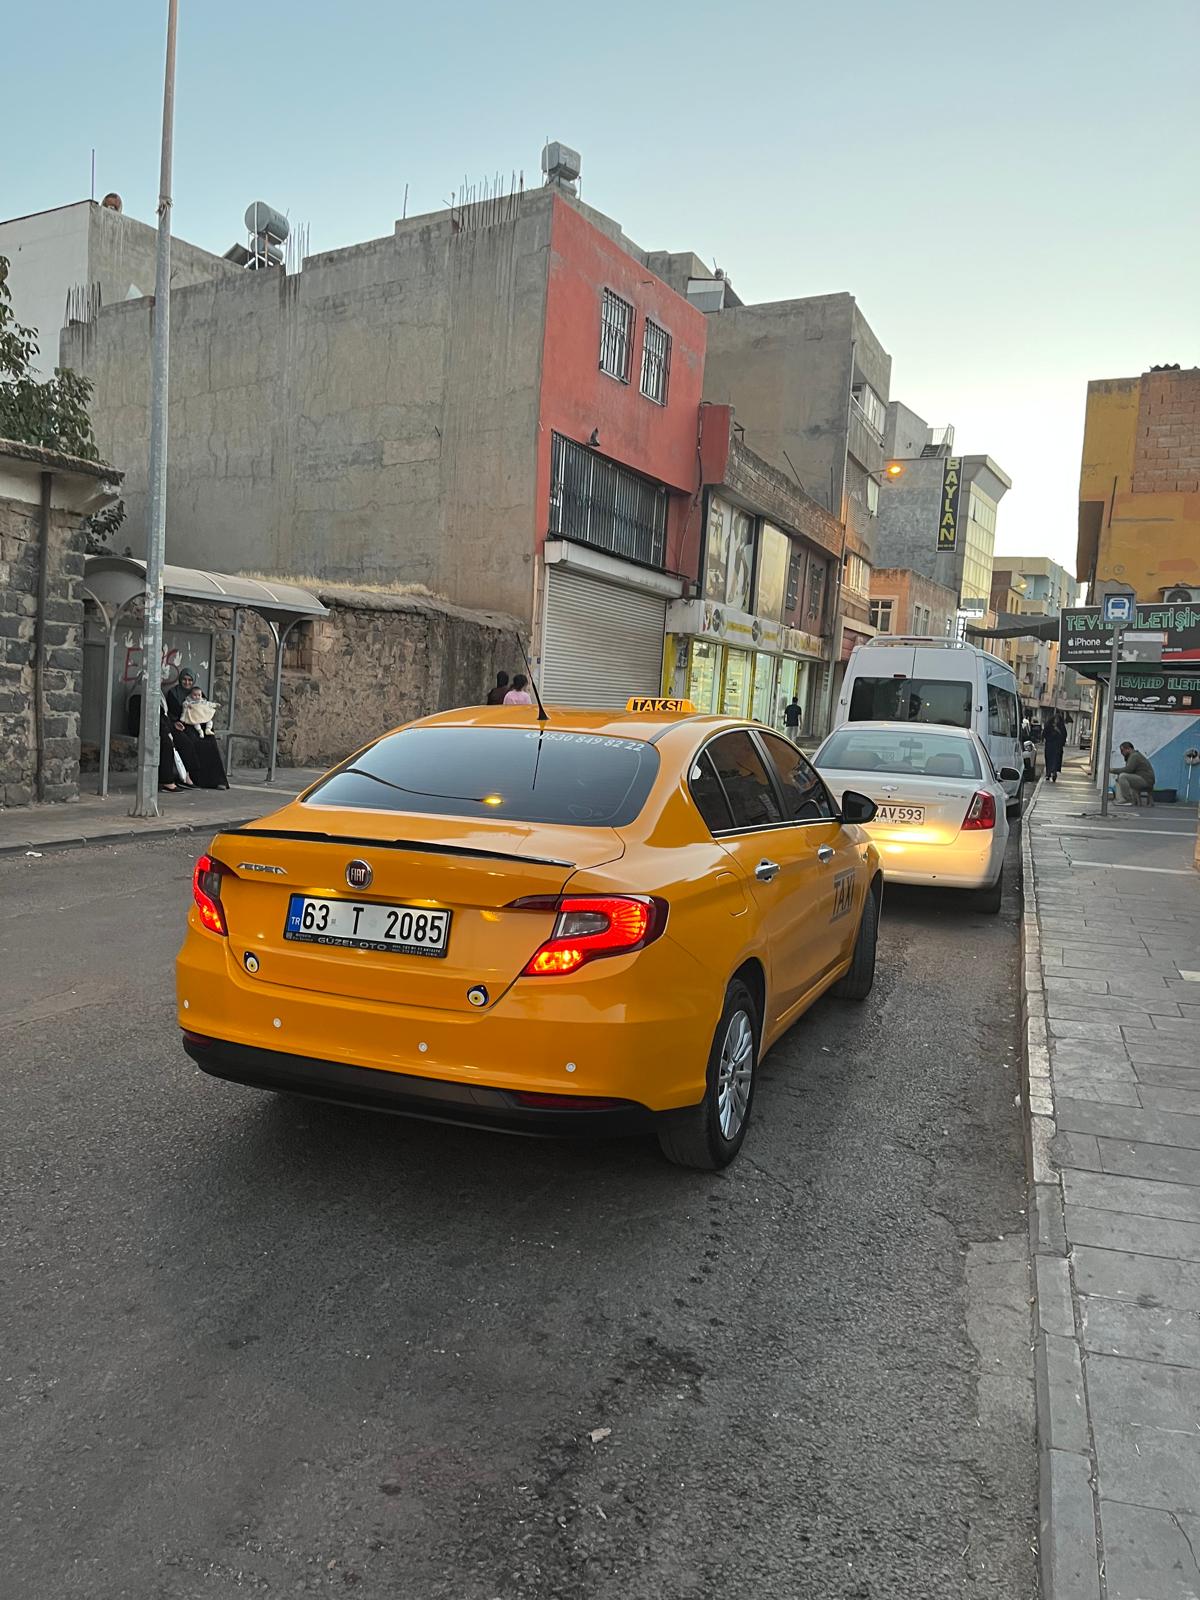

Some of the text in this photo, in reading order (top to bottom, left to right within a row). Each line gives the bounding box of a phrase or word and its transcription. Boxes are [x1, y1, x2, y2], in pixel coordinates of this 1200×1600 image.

[939, 457, 960, 541] BAYLAN
[1074, 637, 1101, 646] iPhone
[575, 735, 602, 746] 849
[604, 738, 623, 749] 82
[624, 741, 645, 752] 22
[898, 808, 922, 821] 593
[350, 867, 366, 883] FIAT
[832, 873, 855, 917] TAXI
[291, 902, 444, 944] TR 63 T 2085
[317, 936, 357, 948] GÜZEL
[359, 941, 388, 951] OTO
